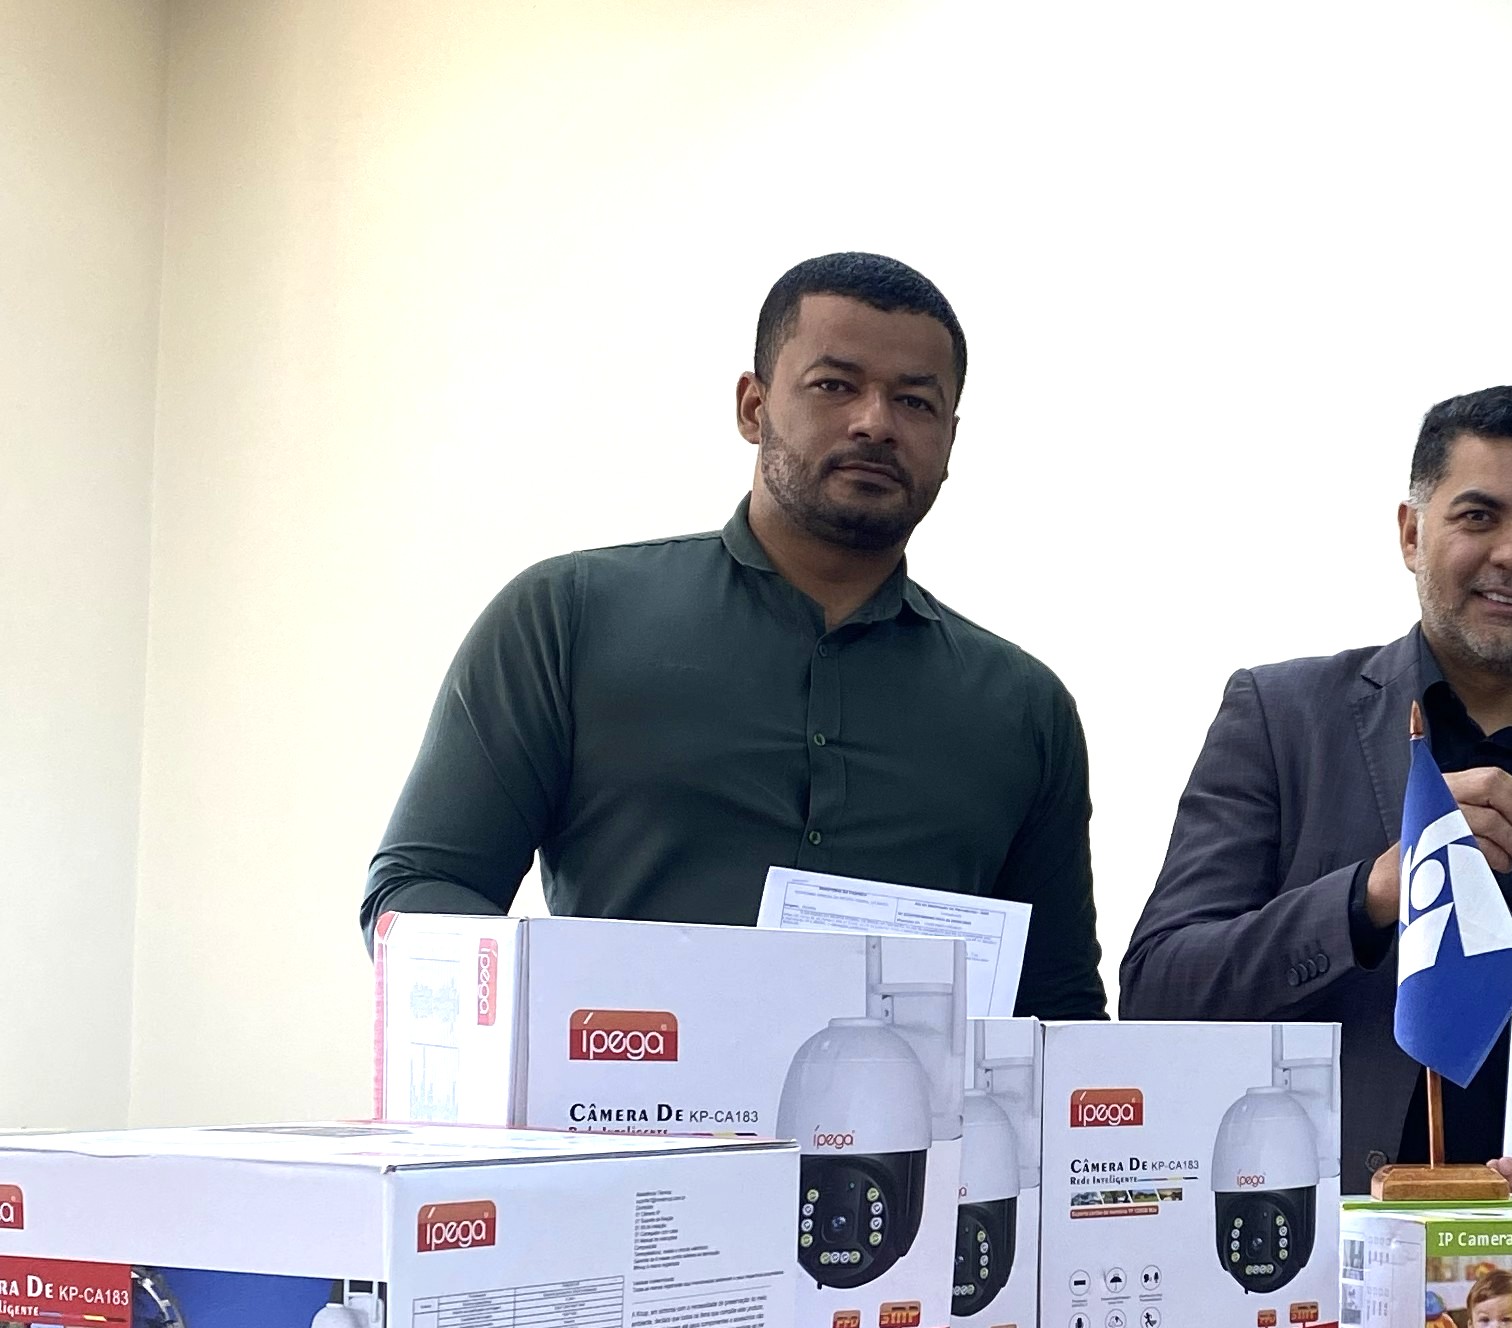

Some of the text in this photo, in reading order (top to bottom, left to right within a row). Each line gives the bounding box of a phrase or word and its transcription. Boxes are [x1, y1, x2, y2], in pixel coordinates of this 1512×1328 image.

[689, 1110, 759, 1123] KP-CA183
[1152, 1160, 1199, 1171] KP-CA183
[1438, 1232, 1453, 1246] IP
[59, 1285, 128, 1305] KP-CA183
